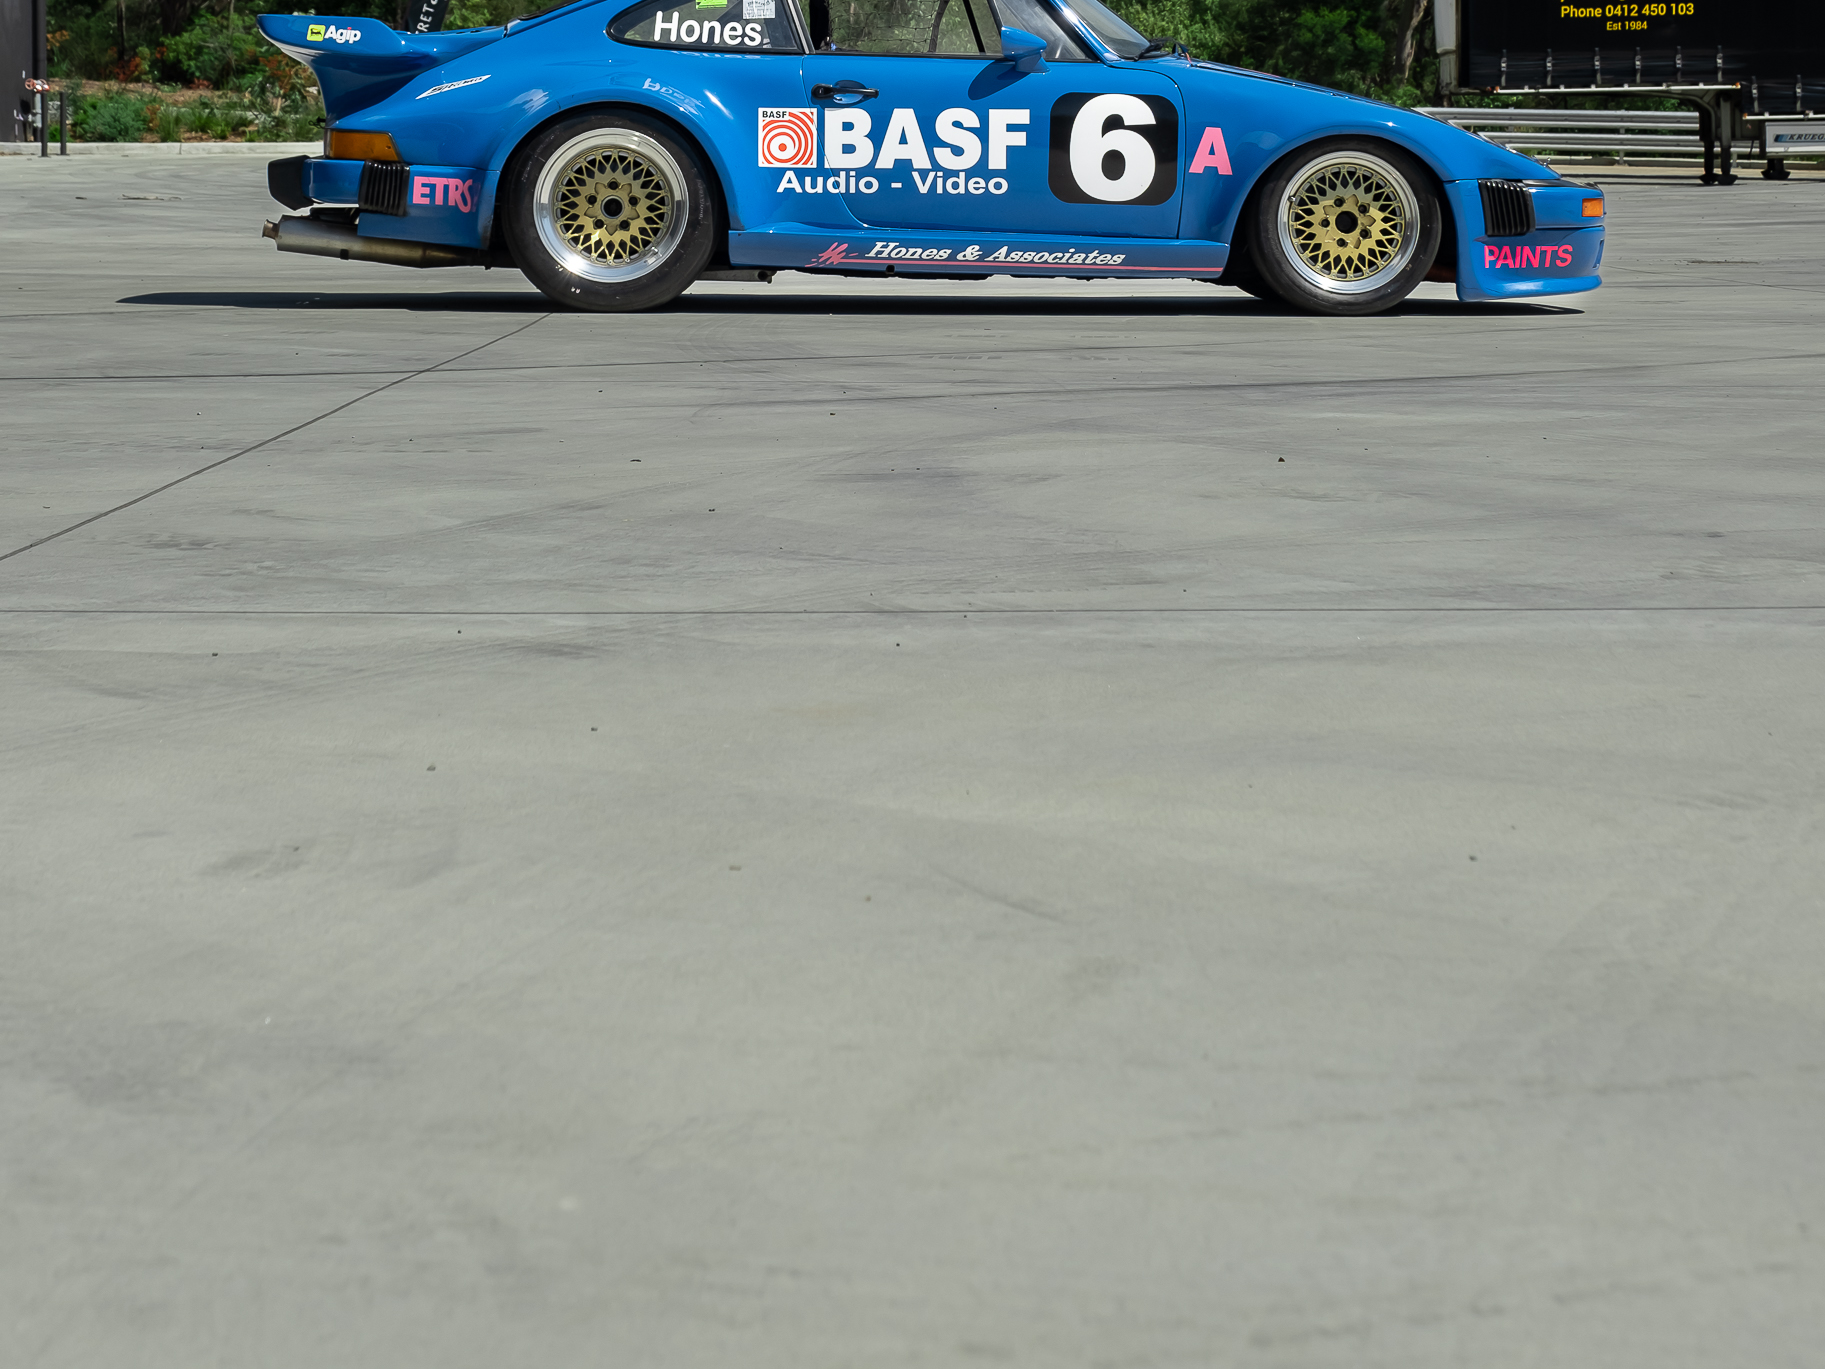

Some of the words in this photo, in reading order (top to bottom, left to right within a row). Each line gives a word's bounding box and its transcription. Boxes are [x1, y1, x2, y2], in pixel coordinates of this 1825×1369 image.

[416, 3, 435, 33] RET
[1561, 5, 1603, 18] Phone
[1605, 4, 1639, 17] 0412
[1641, 3, 1667, 16] 450
[1670, 2, 1695, 16] 103
[324, 25, 362, 44] Agip
[653, 10, 762, 47] Hones
[1606, 21, 1622, 31] Est
[1624, 20, 1648, 30] 1984
[762, 110, 788, 119] BASF
[824, 107, 1031, 169] BASF
[1069, 93, 1157, 202] 6
[1188, 126, 1233, 176] A
[776, 169, 879, 194] Audio
[911, 170, 1009, 195] Video
[864, 241, 952, 260] Hones
[956, 244, 983, 262] &
[984, 245, 1126, 266] Associates
[1484, 244, 1573, 269] PAINTS
